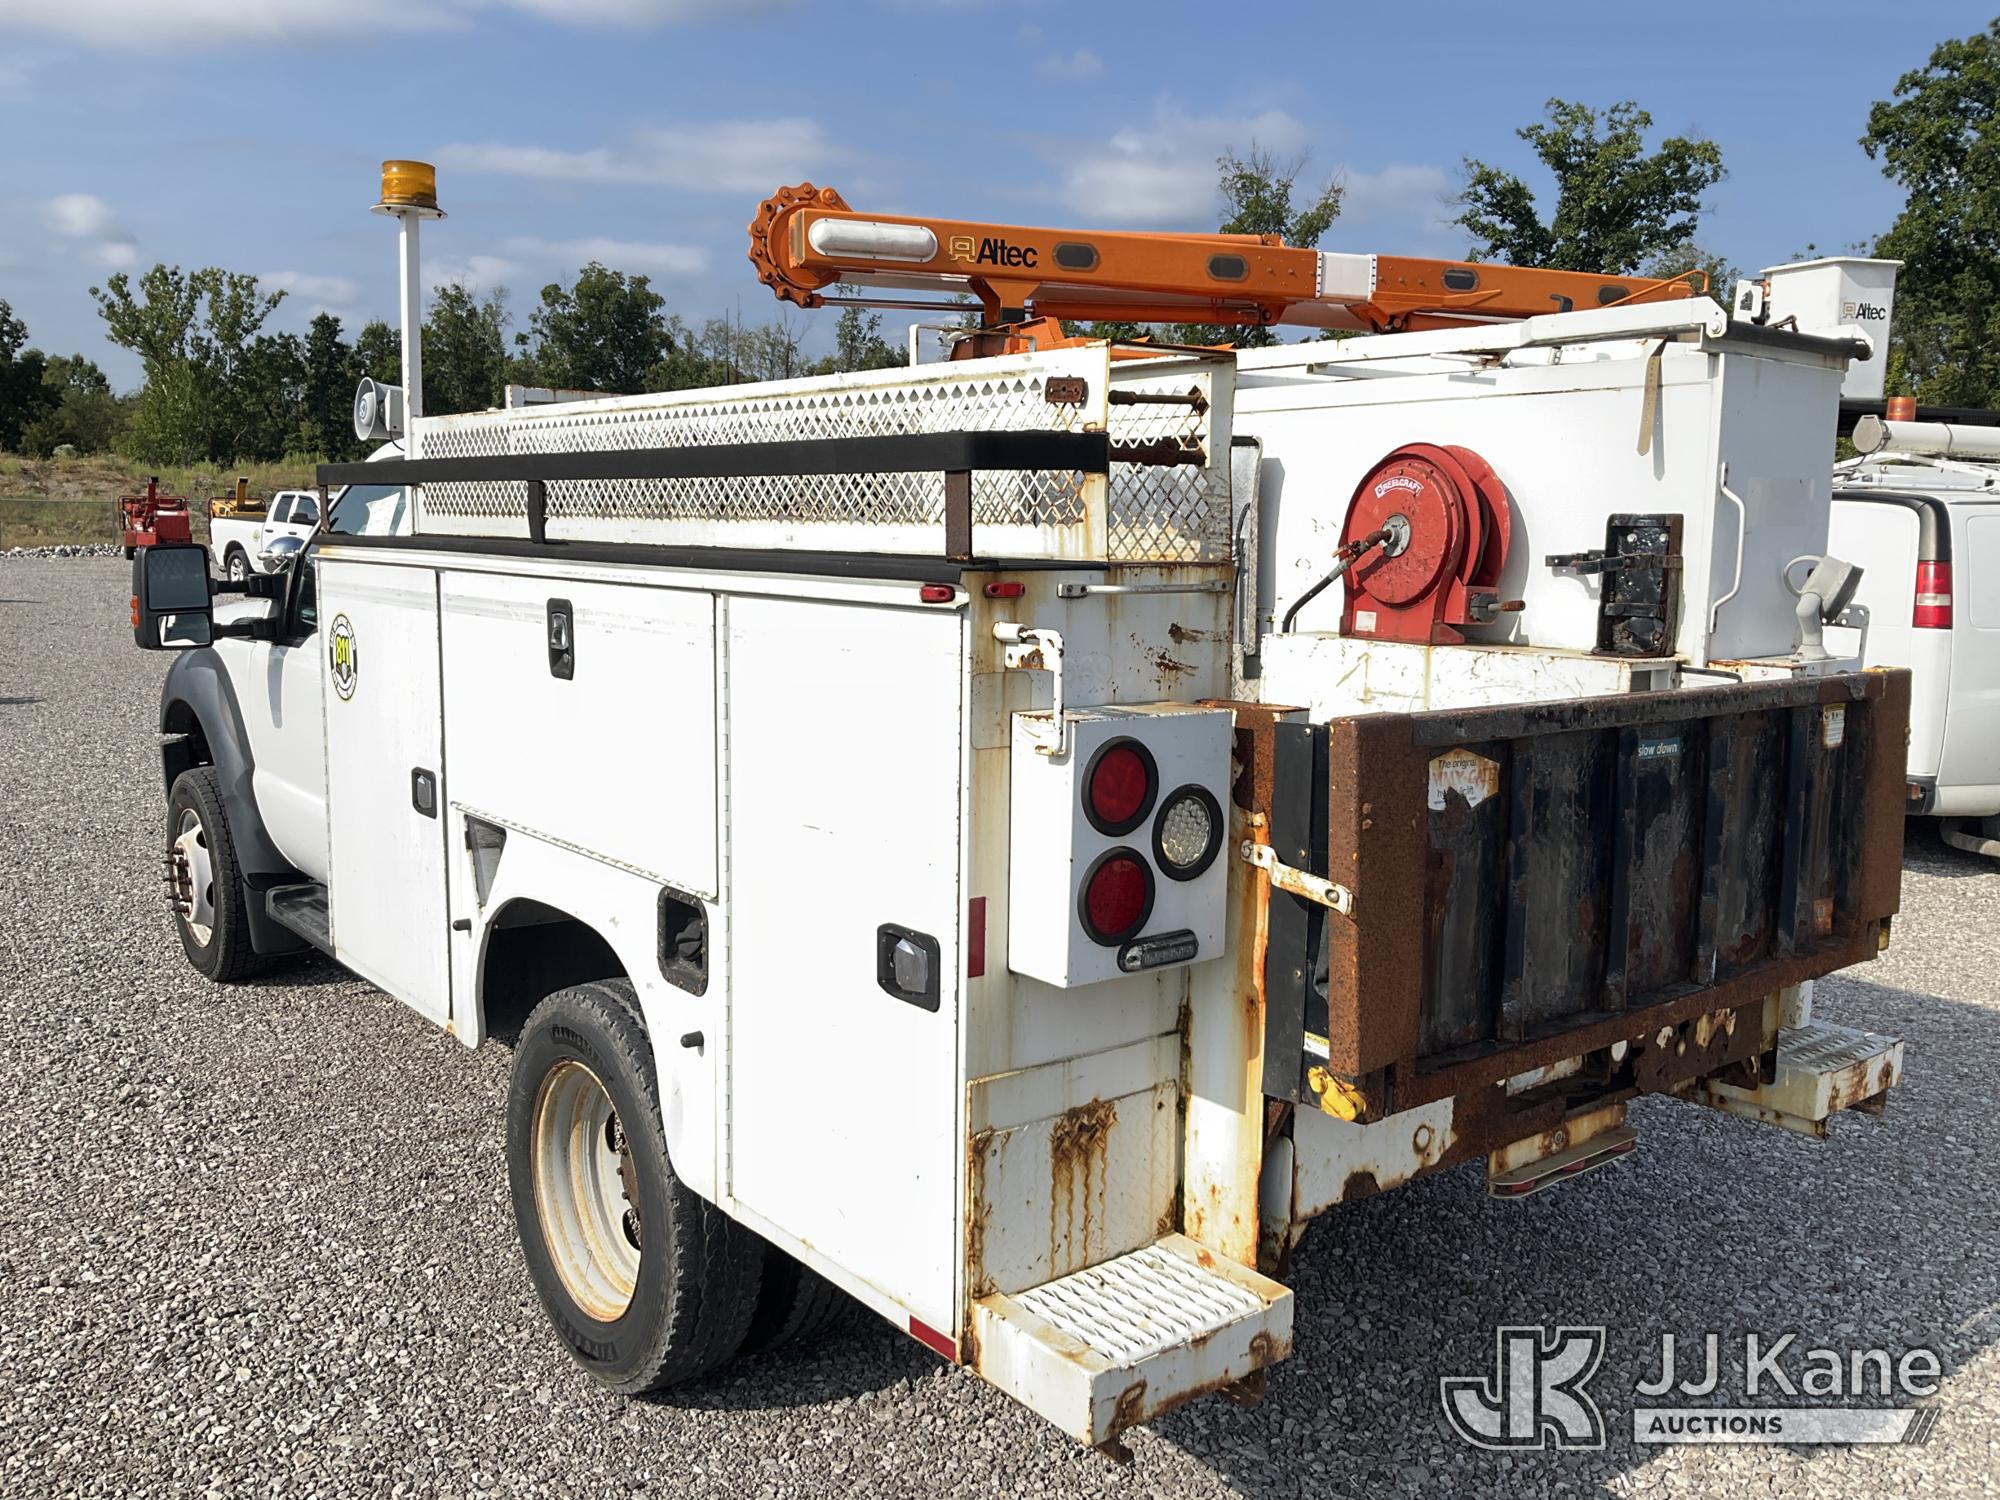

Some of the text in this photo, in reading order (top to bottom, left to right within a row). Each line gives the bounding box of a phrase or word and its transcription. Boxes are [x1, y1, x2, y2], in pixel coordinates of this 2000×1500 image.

[976, 237, 1038, 268] Altec
[1855, 302, 1887, 320] Altec
[1381, 478, 1422, 494] REELCRAFT
[335, 633, 350, 667] 811
[1638, 741, 1678, 757] slow down
[1438, 758, 1477, 770] The original
